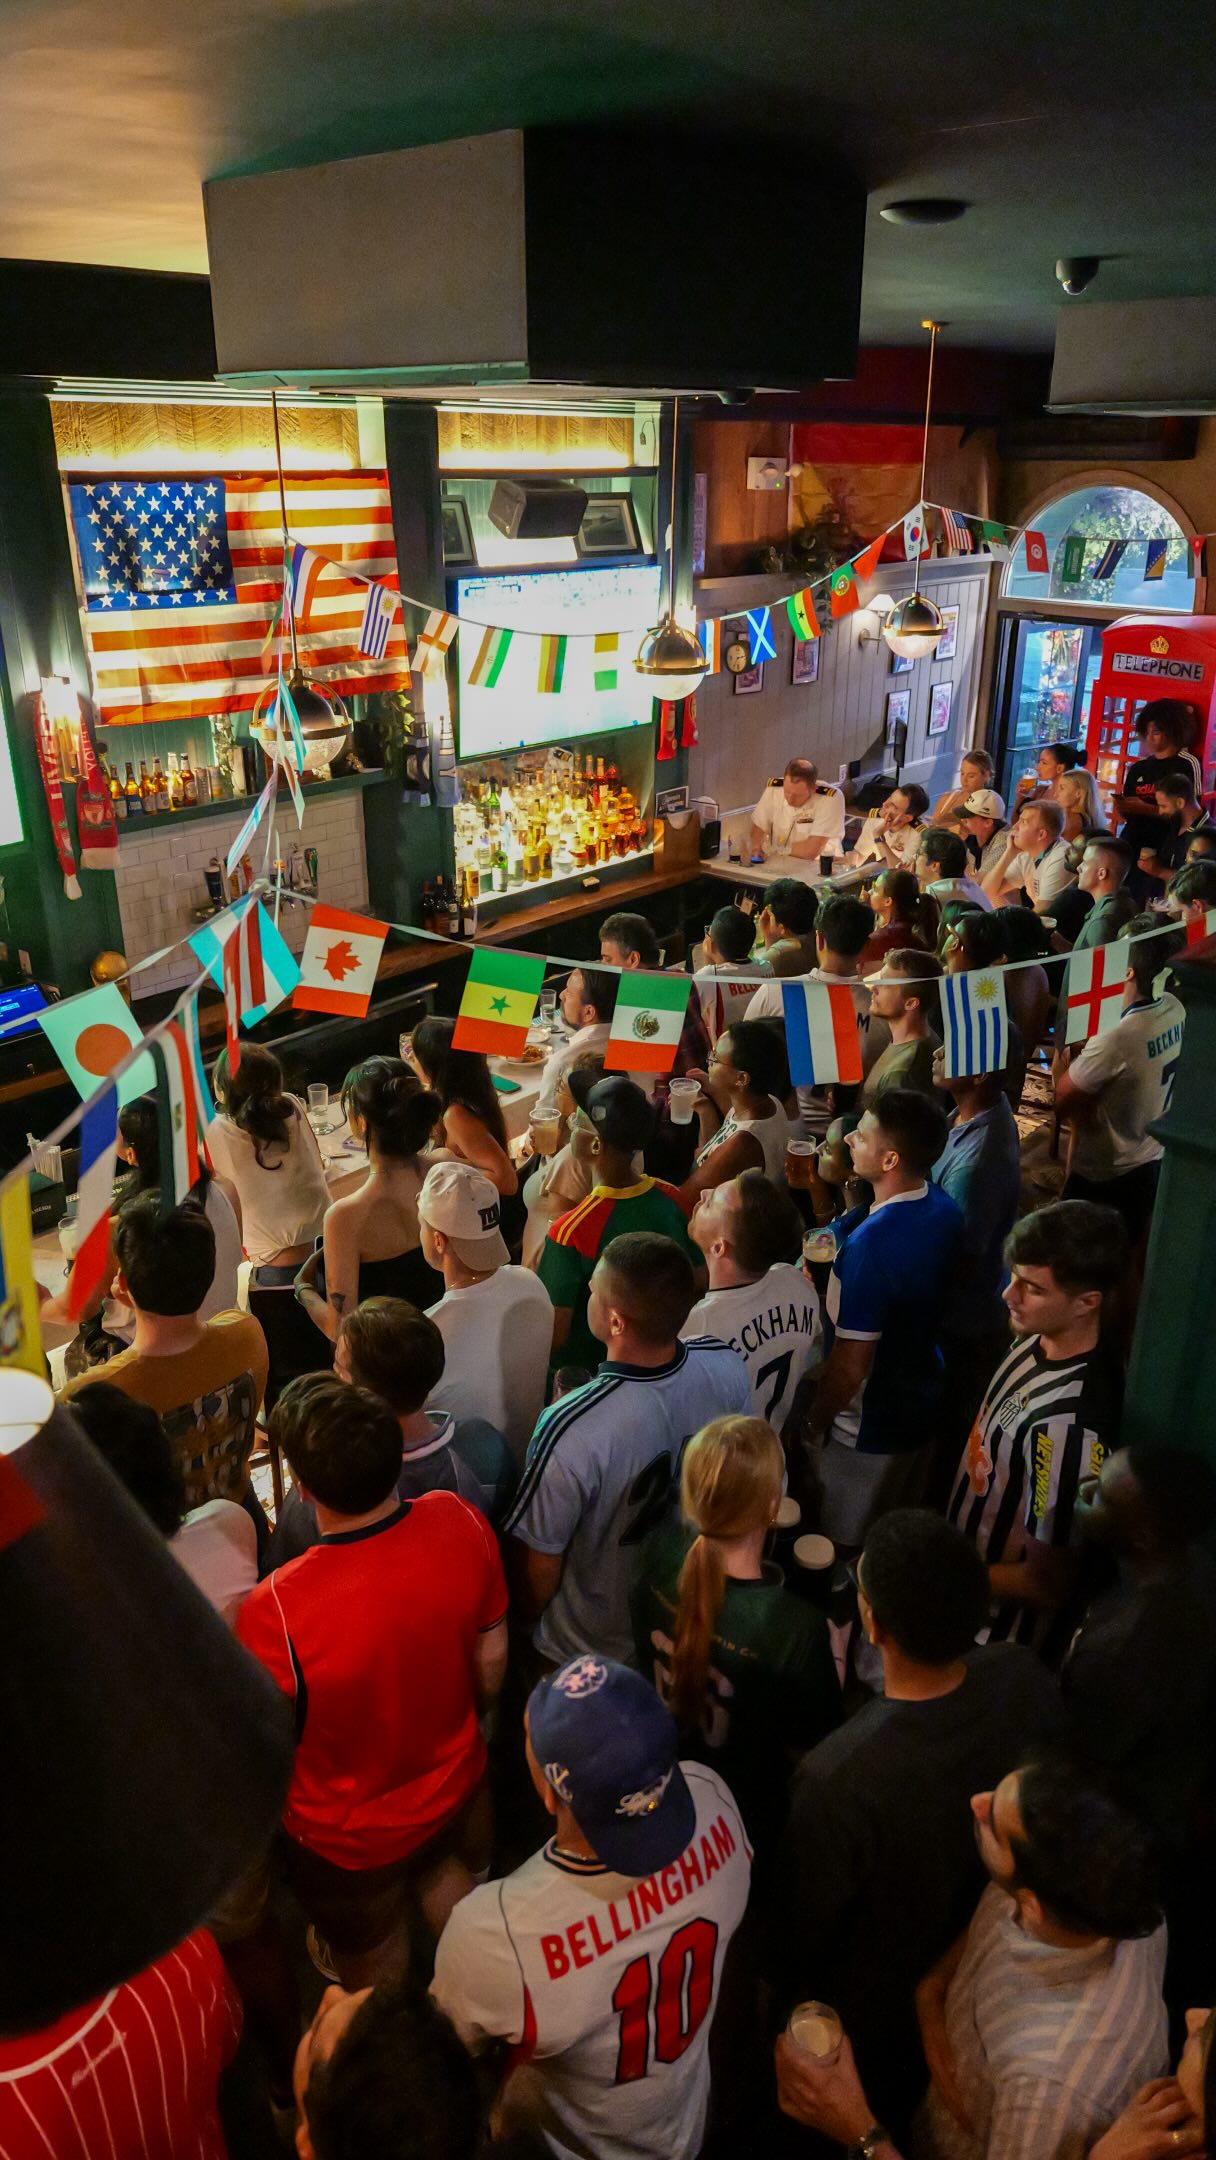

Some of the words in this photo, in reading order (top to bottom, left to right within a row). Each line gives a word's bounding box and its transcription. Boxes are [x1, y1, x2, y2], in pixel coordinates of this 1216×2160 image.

[1115, 654, 1203, 680] TELEPHONE
[728, 1303, 814, 1362] ECKHAM
[755, 1349, 796, 1423] 7
[541, 1815, 736, 1981] BELLINGHAM
[612, 1917, 718, 2085] 10
